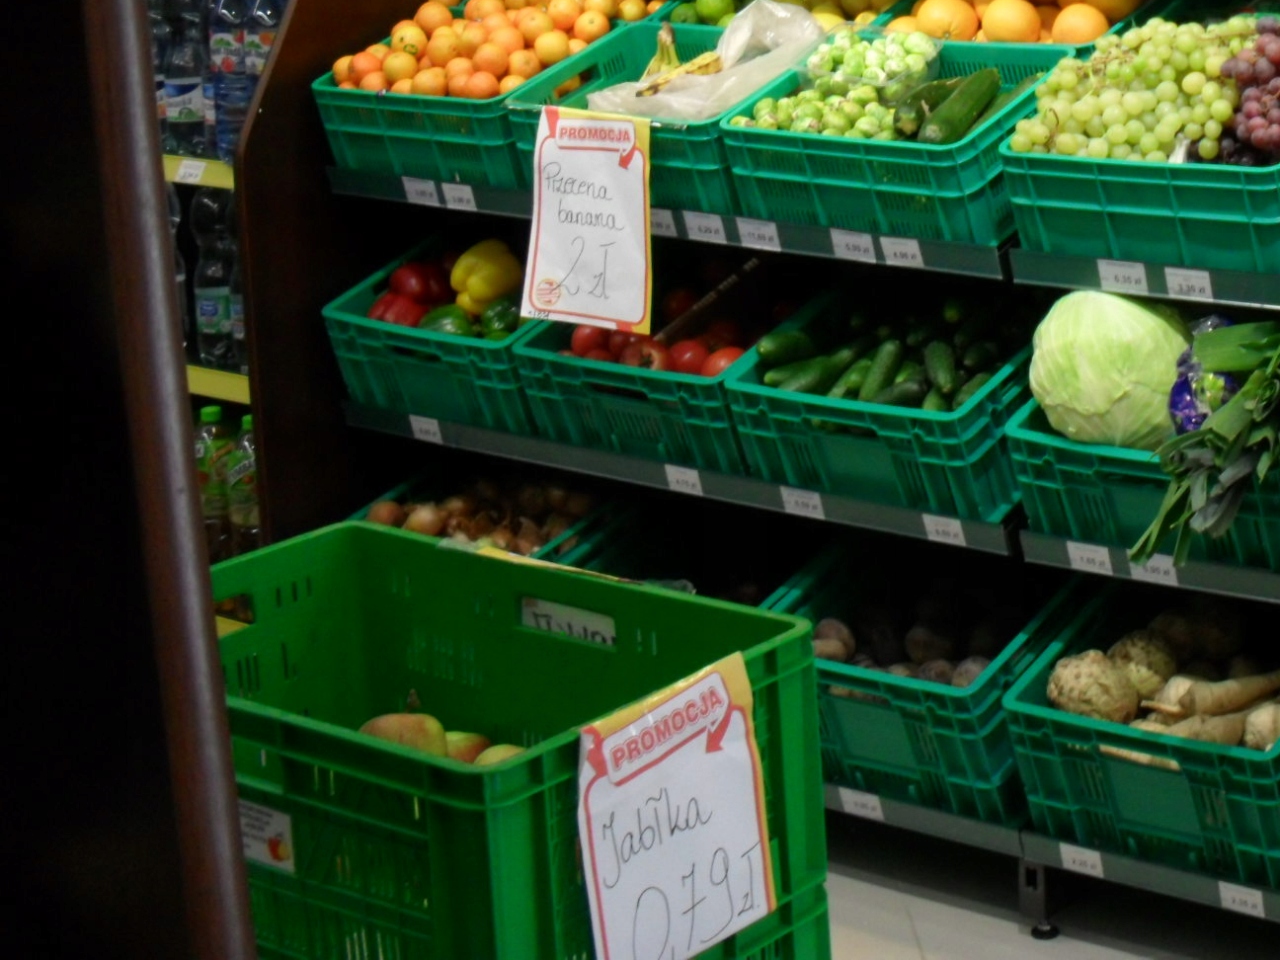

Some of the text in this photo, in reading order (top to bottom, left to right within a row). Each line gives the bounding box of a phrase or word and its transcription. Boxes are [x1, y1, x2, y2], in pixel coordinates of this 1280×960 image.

[559, 126, 631, 141] PROMOCJA
[550, 236, 616, 299] 2 zł
[611, 686, 724, 771] PROMOCJA
[601, 788, 713, 889] Jabłka
